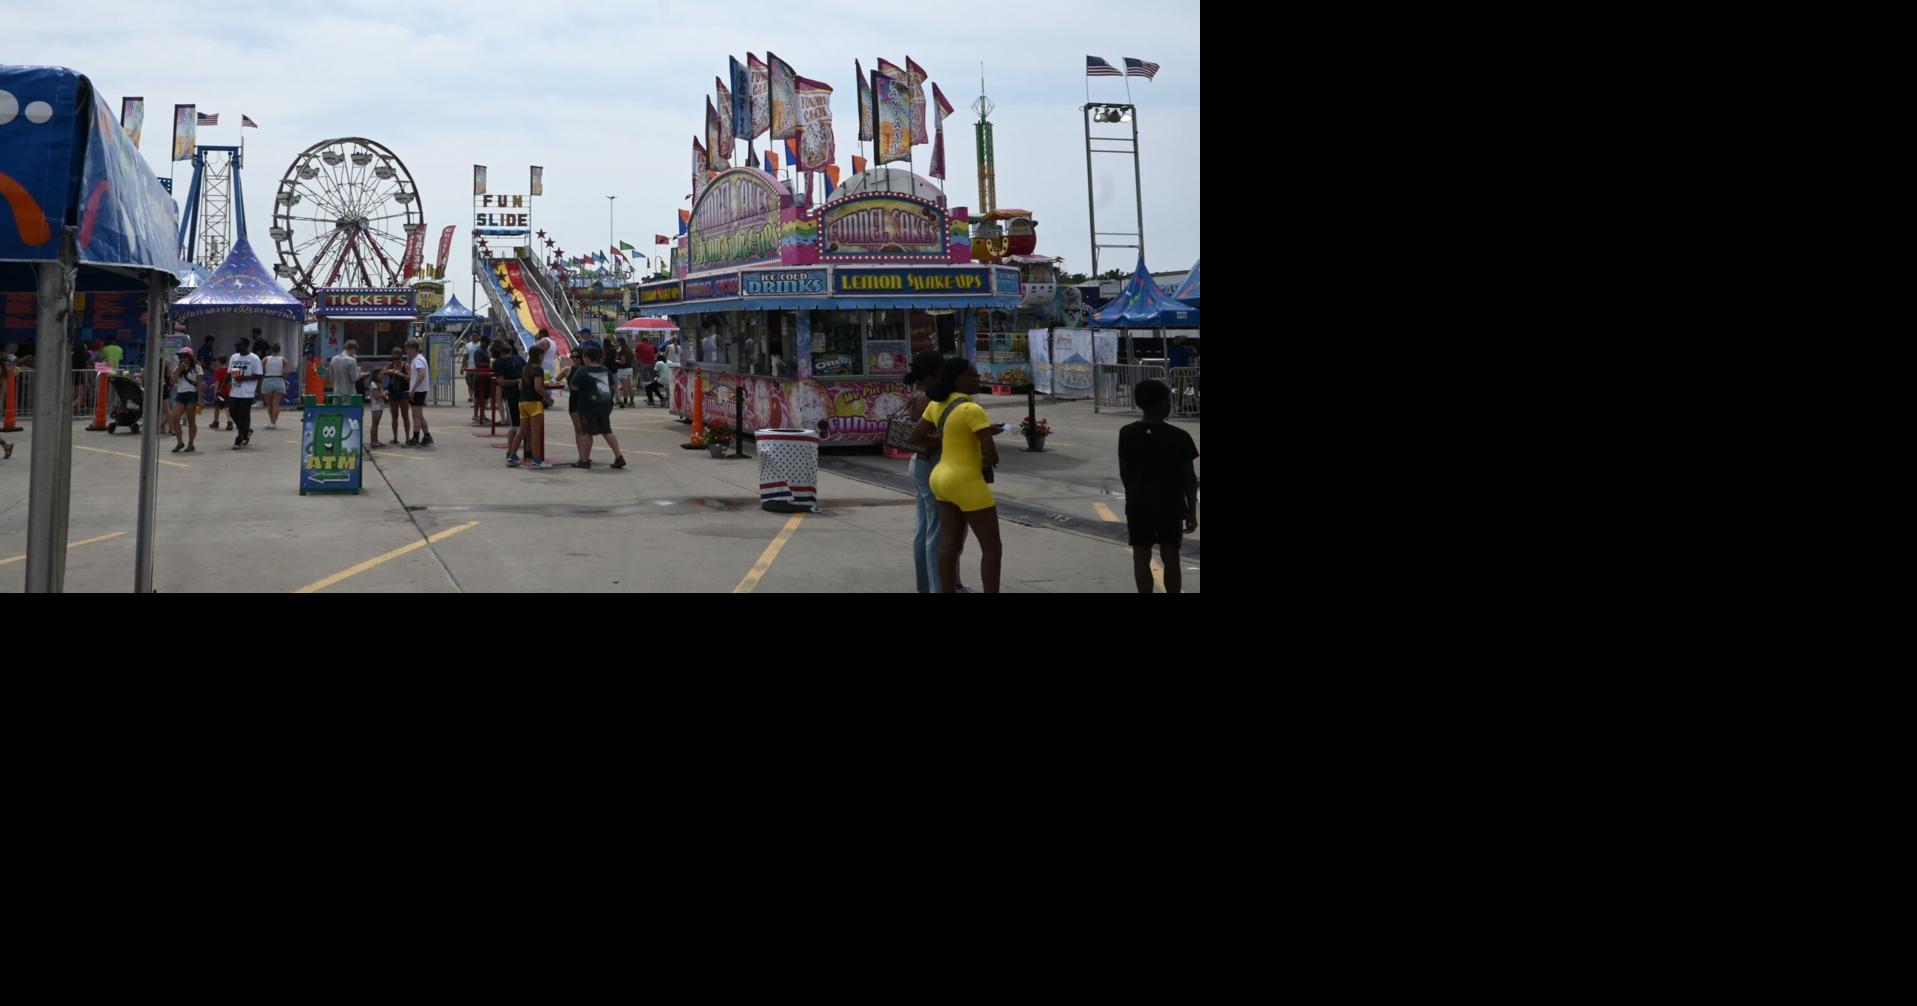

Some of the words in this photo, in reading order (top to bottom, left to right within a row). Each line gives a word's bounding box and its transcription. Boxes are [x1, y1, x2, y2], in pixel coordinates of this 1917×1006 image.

[801, 95, 826, 109] FUNNEL
[483, 194, 523, 207] FUN
[476, 213, 528, 227] SLIDE
[829, 207, 887, 244] FUNNEL
[892, 207, 937, 244] CAKES
[780, 273, 808, 281] COLD
[841, 275, 902, 289] LEMON
[749, 279, 823, 294] DRINKS
[329, 294, 408, 306] TICKETS
[305, 455, 357, 470] ATM
